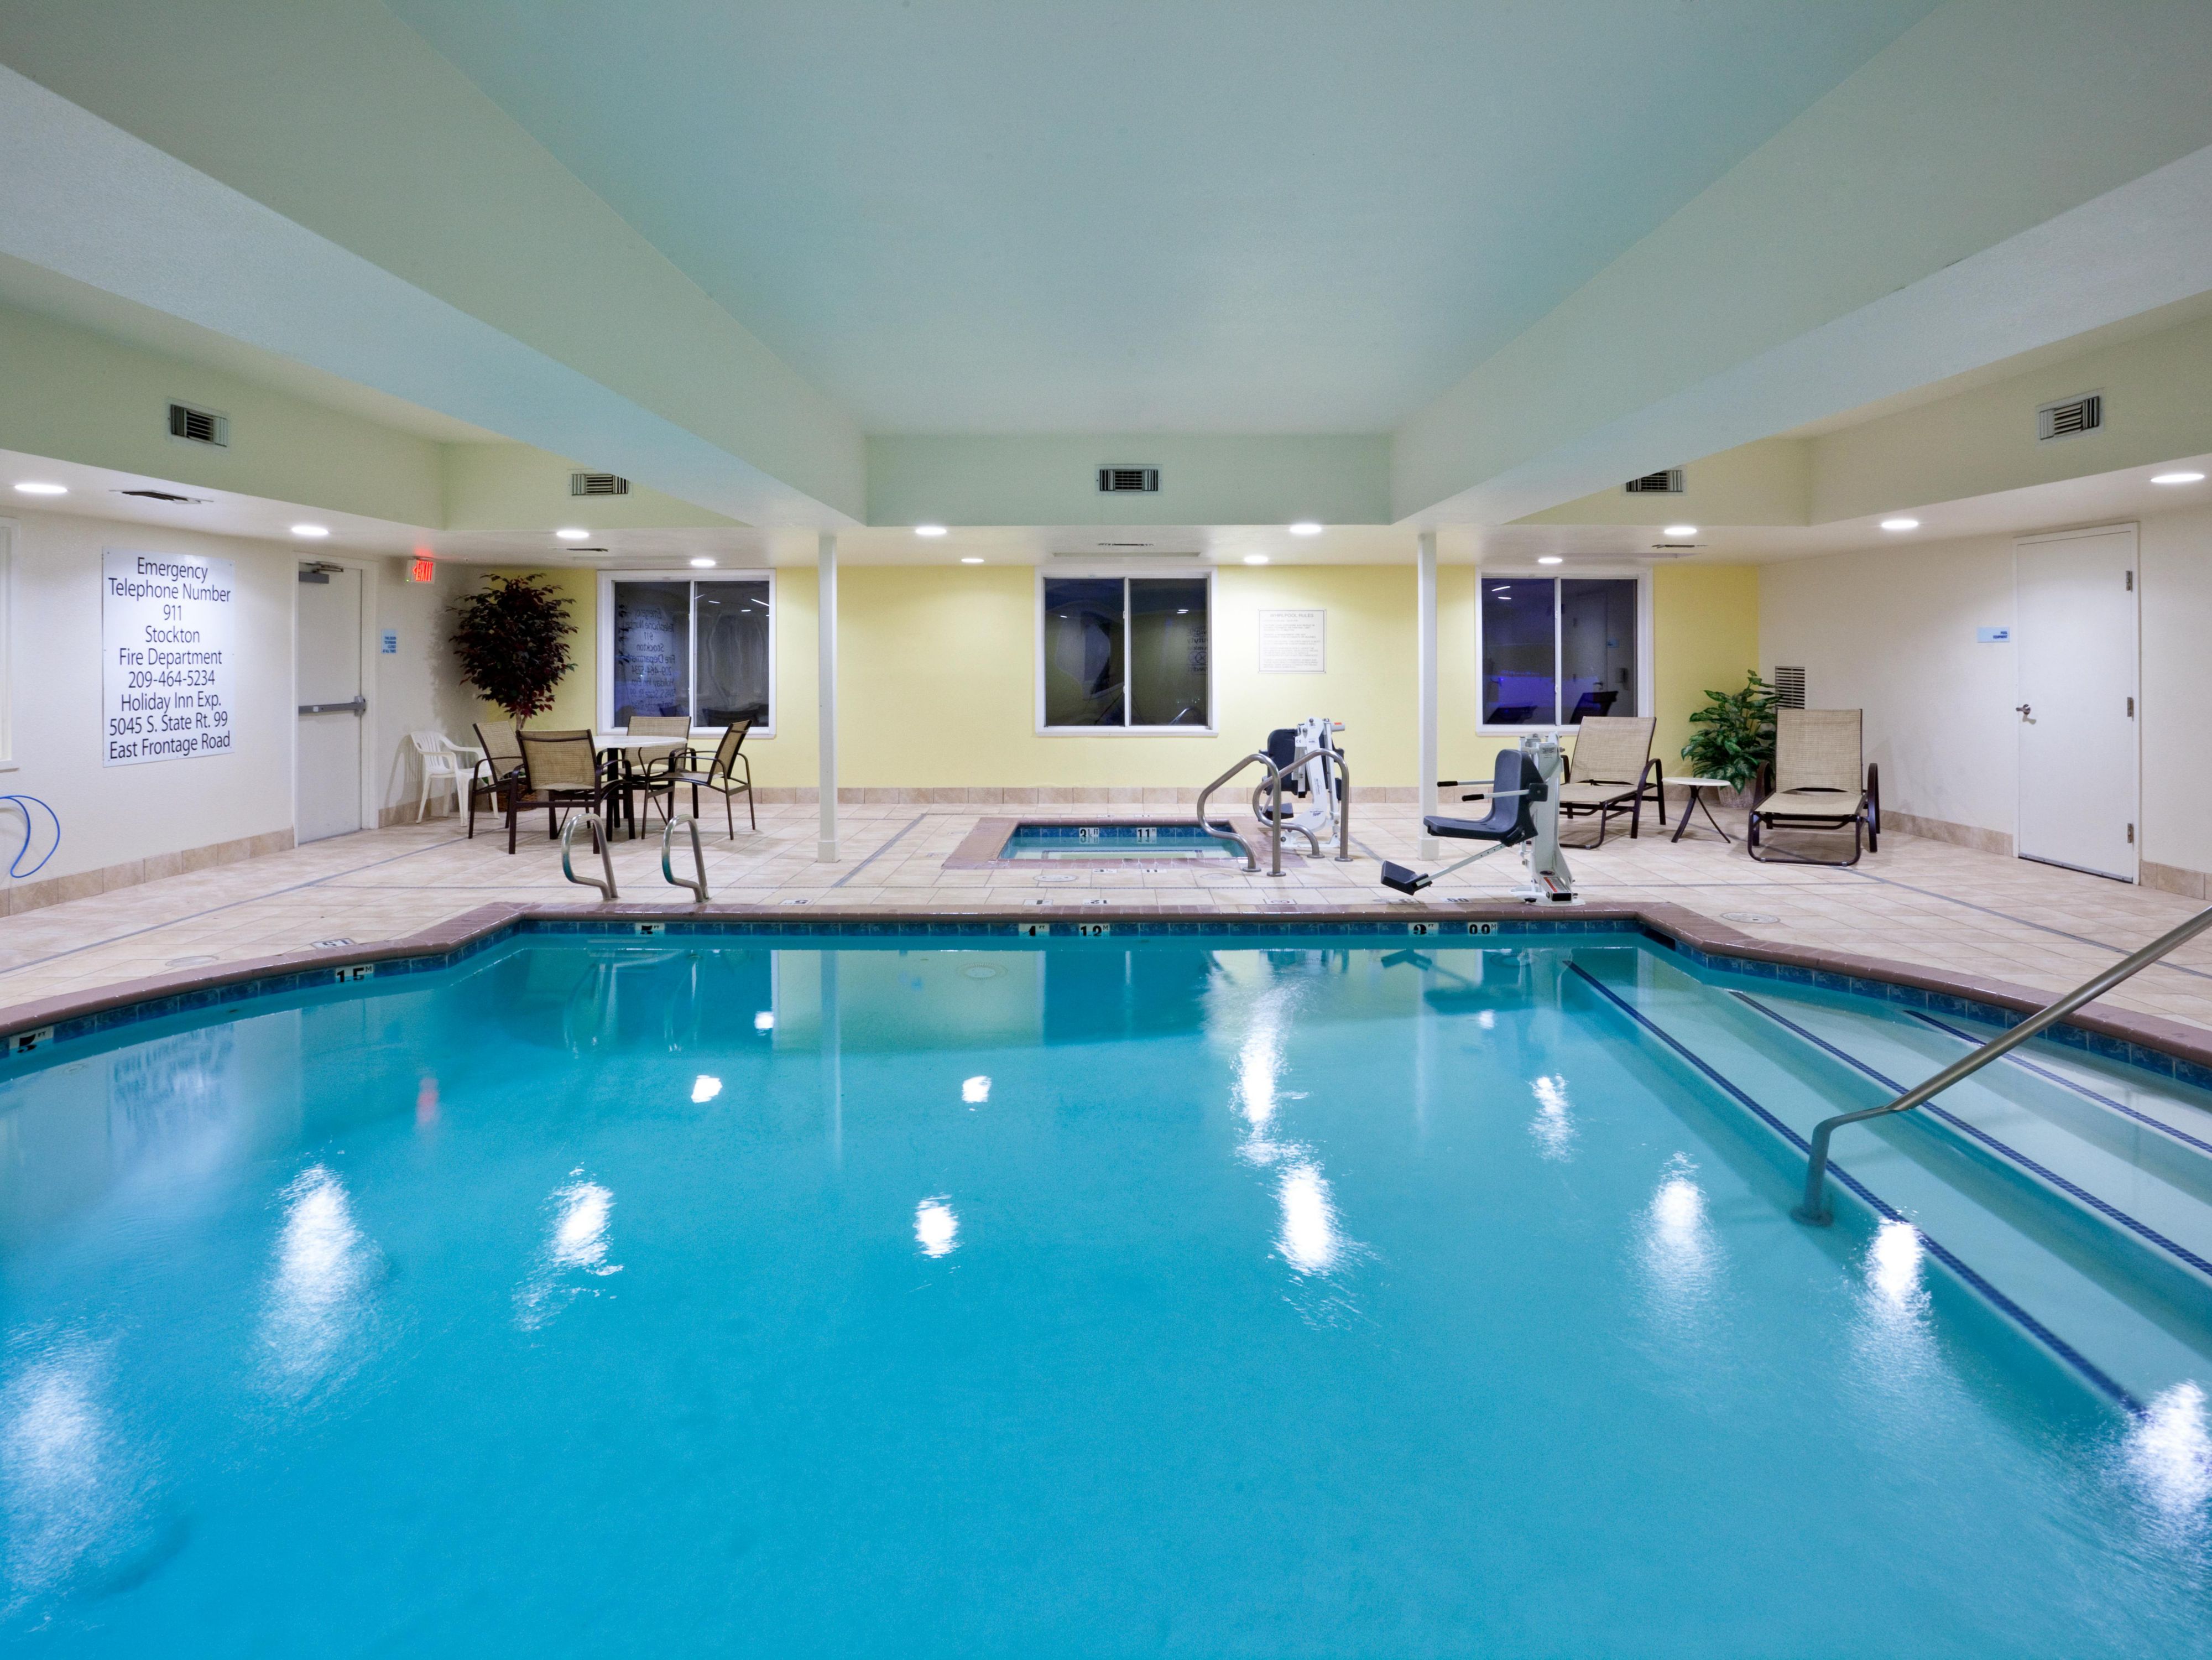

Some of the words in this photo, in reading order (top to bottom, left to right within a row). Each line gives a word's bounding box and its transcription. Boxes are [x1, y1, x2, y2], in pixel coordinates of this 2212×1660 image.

[138, 557, 208, 584] Emergency
[416, 560, 433, 581] EXIT
[108, 577, 179, 601] Telephone
[183, 583, 231, 602] Number
[163, 604, 181, 621] 911
[145, 625, 200, 643] Stockton
[120, 648, 143, 665] Fire
[148, 648, 222, 669] Department
[128, 670, 215, 688] 209-464-5234
[121, 692, 170, 714] Holiday
[175, 692, 193, 709] Inn
[197, 691, 221, 711] Exp.
[109, 717, 142, 736] 5045
[147, 715, 157, 733] S.
[161, 714, 192, 732] State
[196, 712, 211, 728] Rt.
[213, 711, 228, 727] 99
[110, 741, 138, 759] East
[142, 738, 197, 756] Frontage
[201, 730, 230, 749] Road
